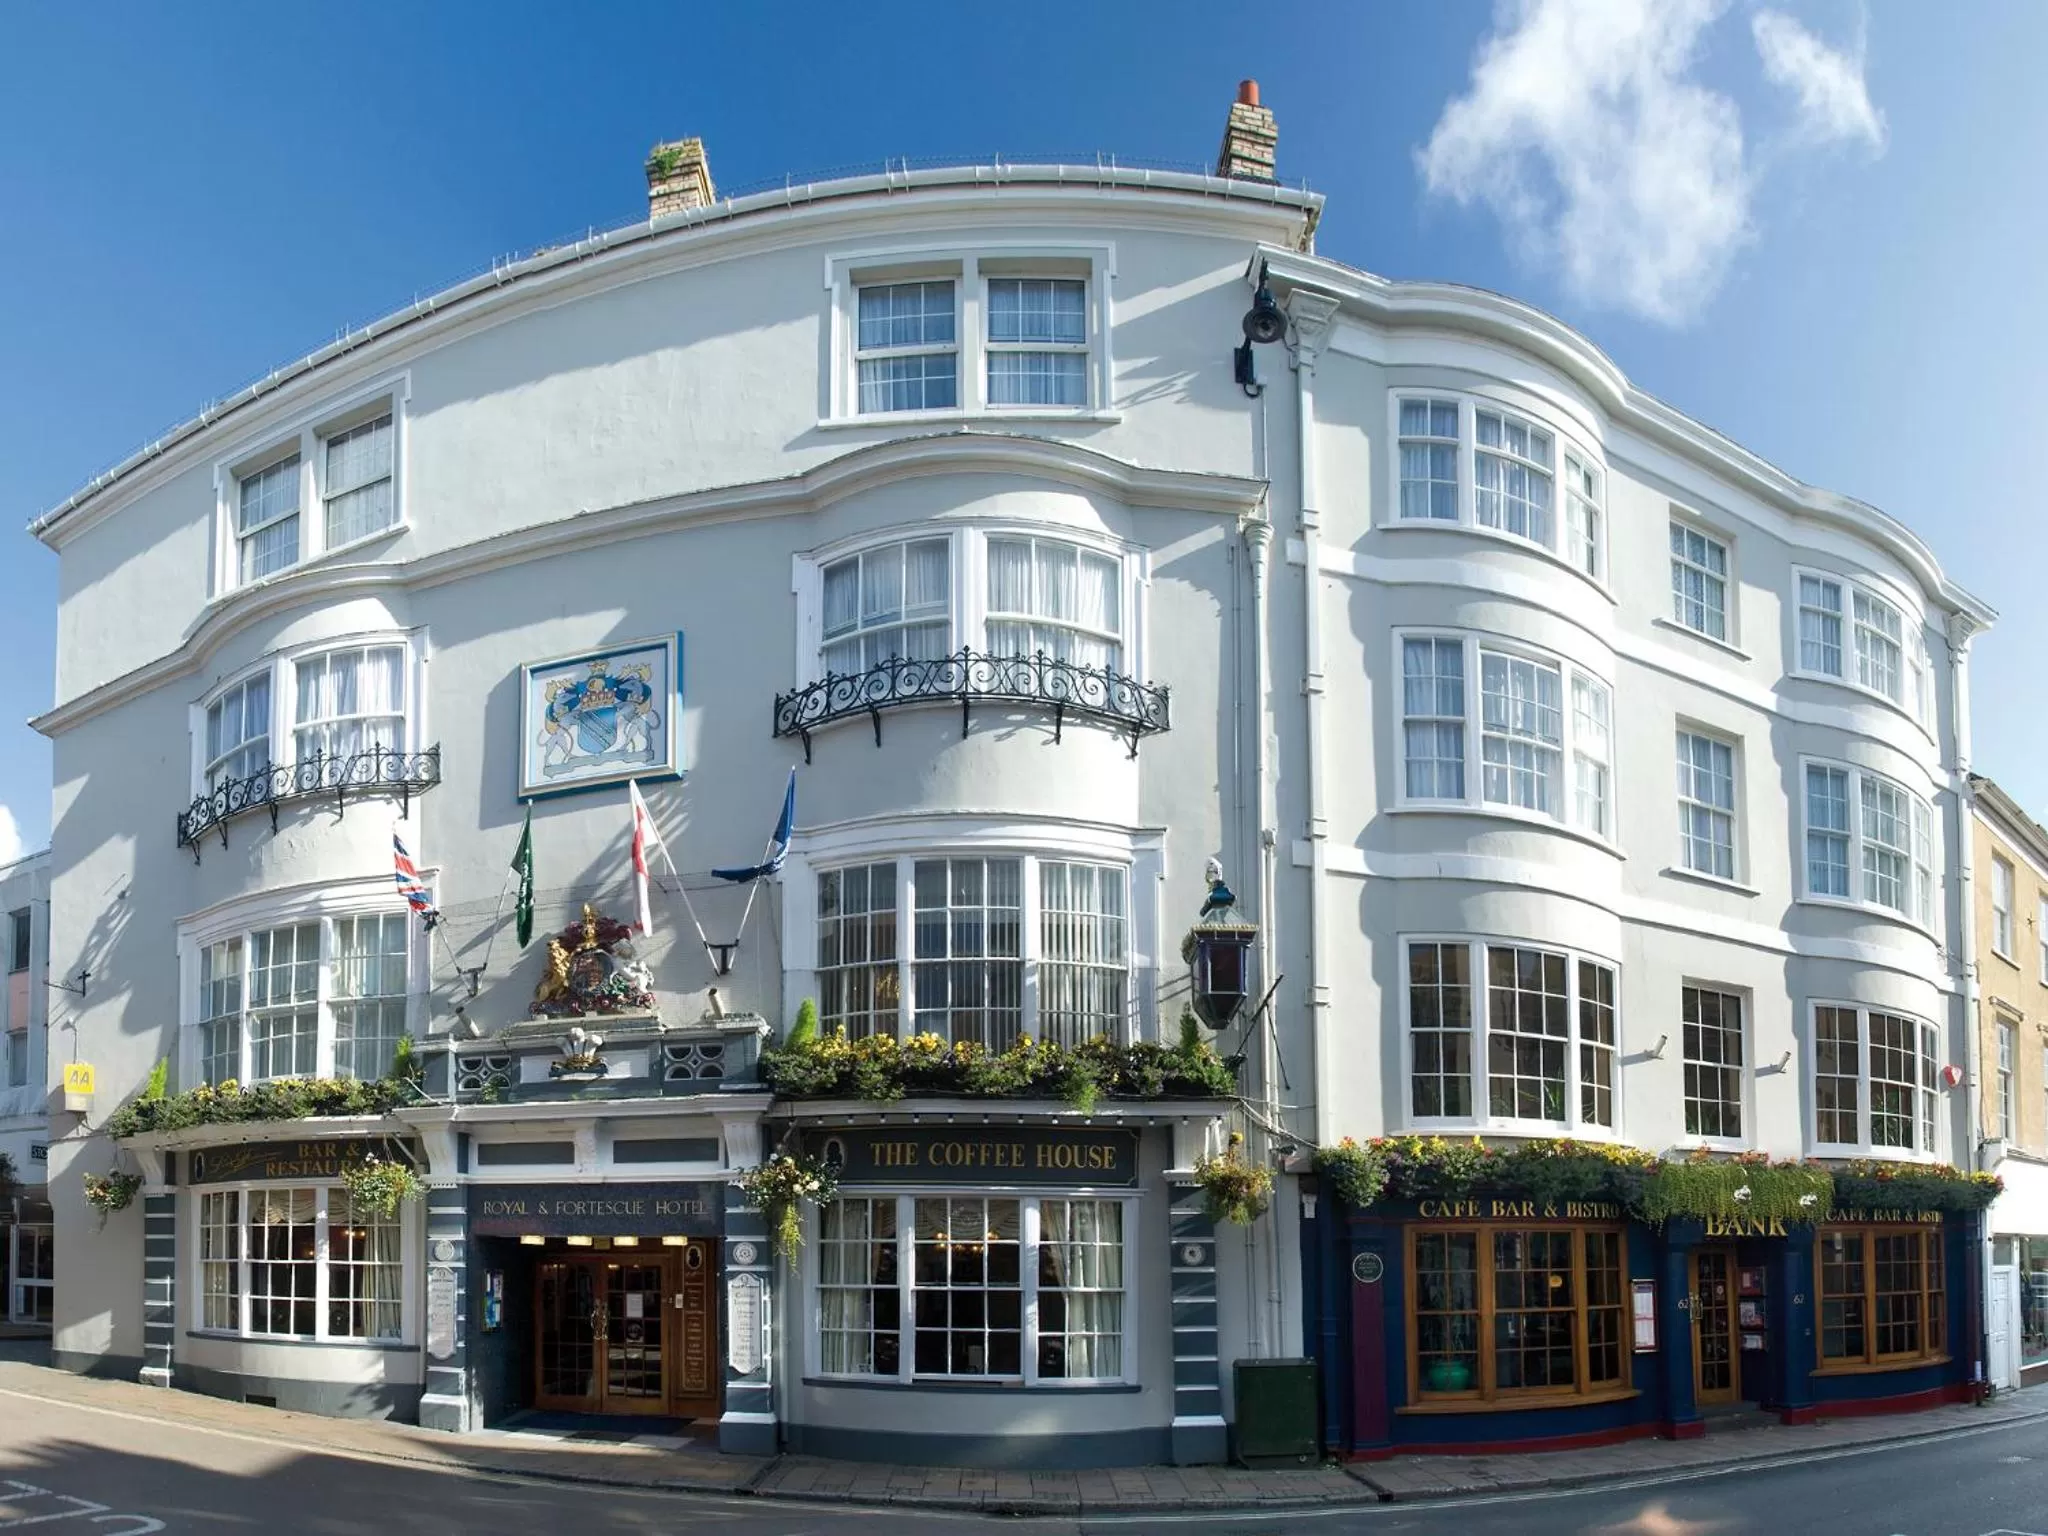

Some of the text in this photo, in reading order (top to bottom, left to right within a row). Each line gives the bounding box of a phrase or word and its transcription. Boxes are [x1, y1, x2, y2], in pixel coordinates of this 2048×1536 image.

[69, 1070, 90, 1085] AA
[298, 1142, 360, 1157] BAR &
[870, 1142, 1117, 1169] THE COFFEE HOUSE
[265, 1160, 352, 1177] RESTAUR
[484, 1200, 710, 1216] ROYAL & FORTESCUE HOTEL
[1419, 1197, 1481, 1217] CAFÉ
[1491, 1200, 1536, 1217] BAR
[1544, 1201, 1558, 1218] &
[1873, 1208, 1901, 1221] BAR
[1905, 1209, 1914, 1222] &
[1704, 1212, 1789, 1236] BANK
